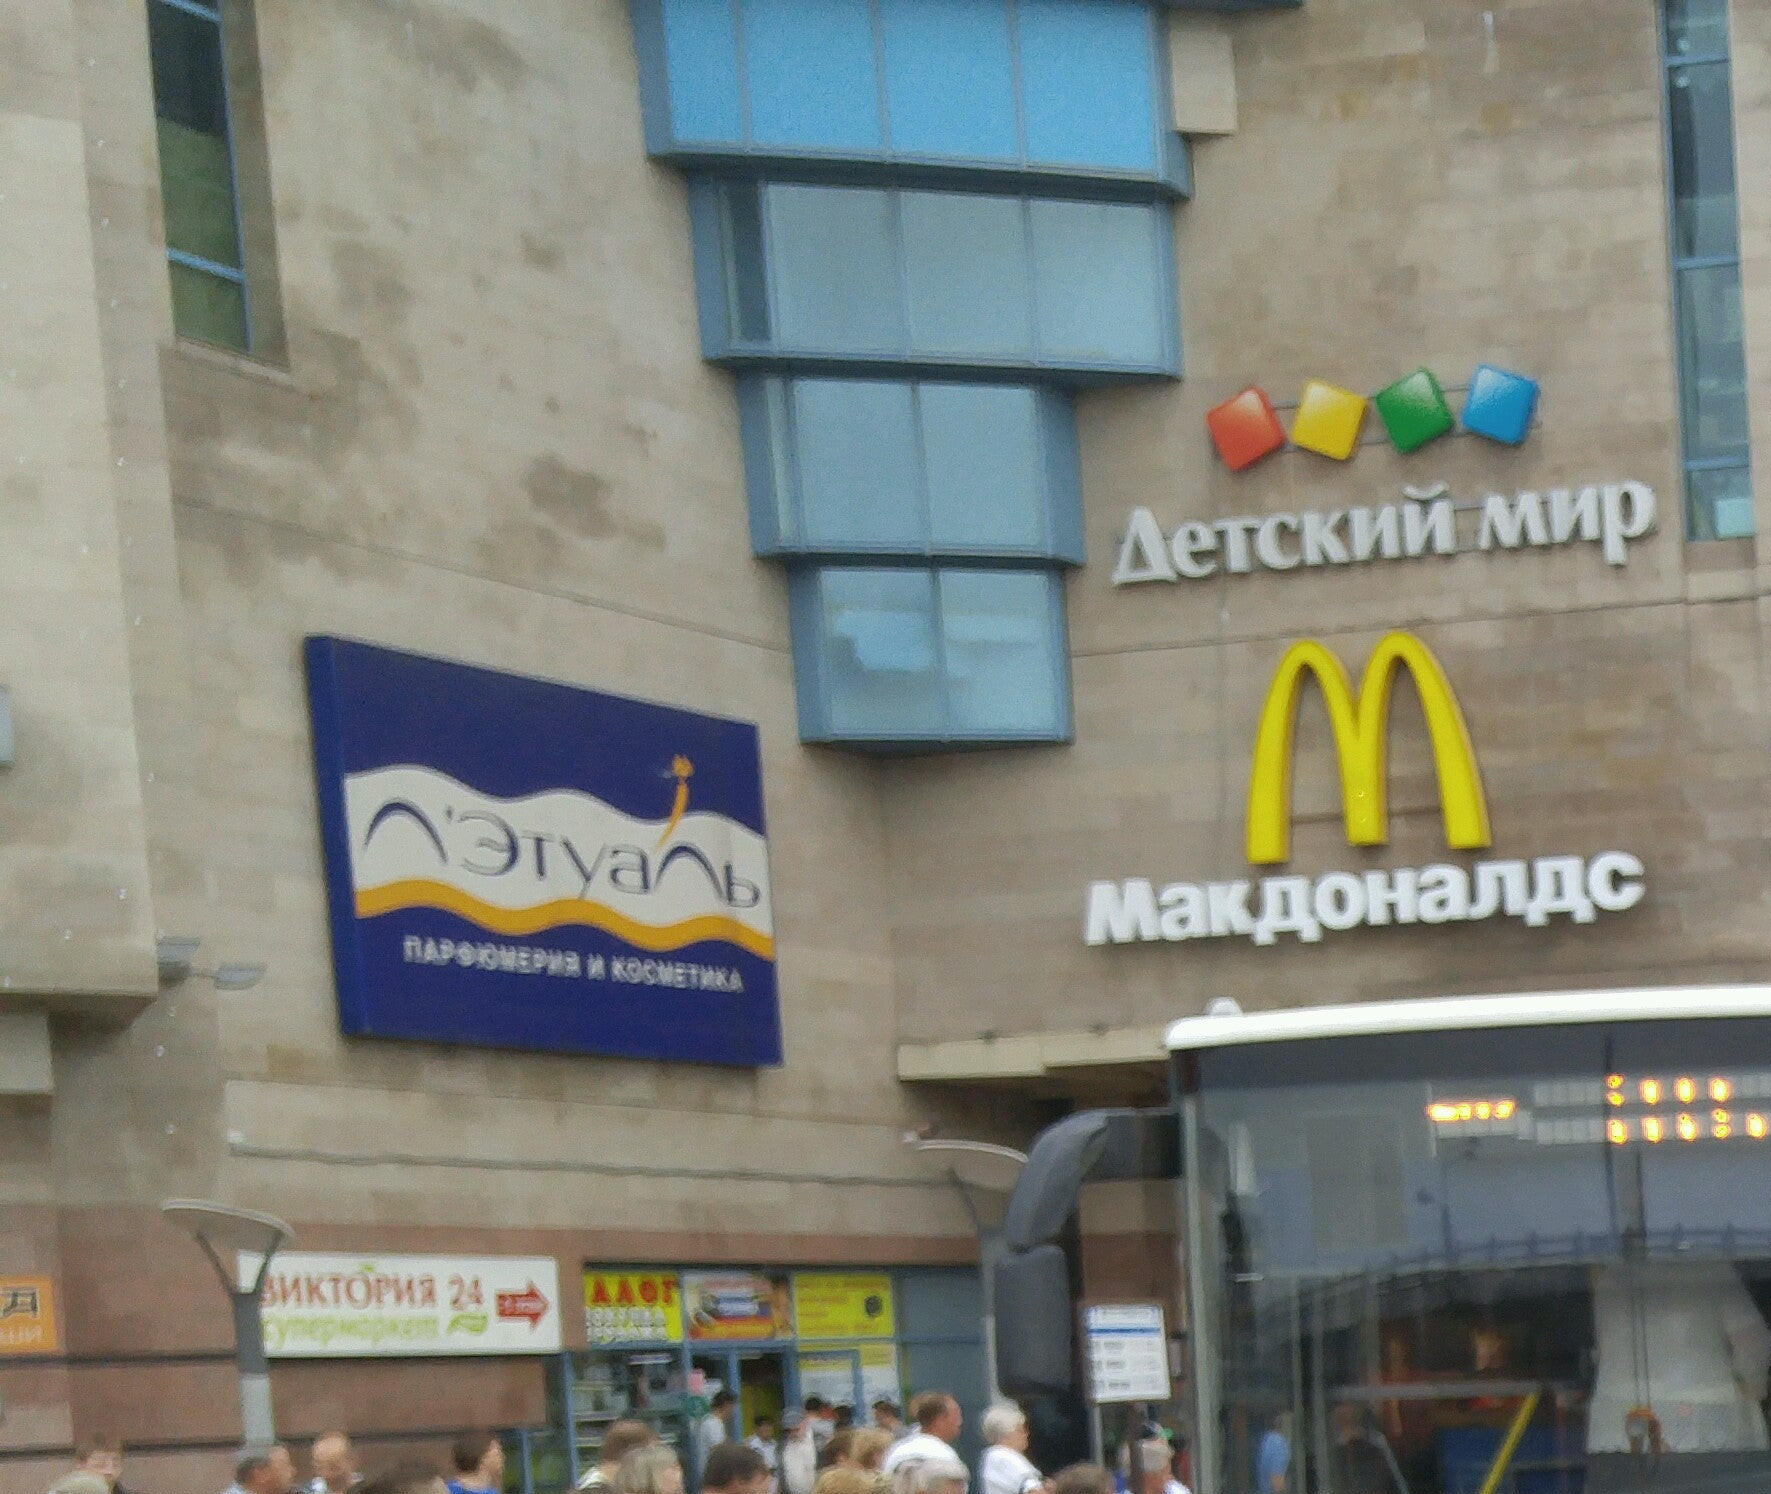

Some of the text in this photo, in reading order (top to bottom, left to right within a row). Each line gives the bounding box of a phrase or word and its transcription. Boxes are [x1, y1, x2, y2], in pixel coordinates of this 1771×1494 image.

[1112, 479, 1657, 586] Детский мир
[1084, 849, 1646, 948] Макдоналдс
[402, 933, 745, 994] ПАРФЮМЕРИЯ И КОСМЕТИКА
[448, 1274, 484, 1311] 24
